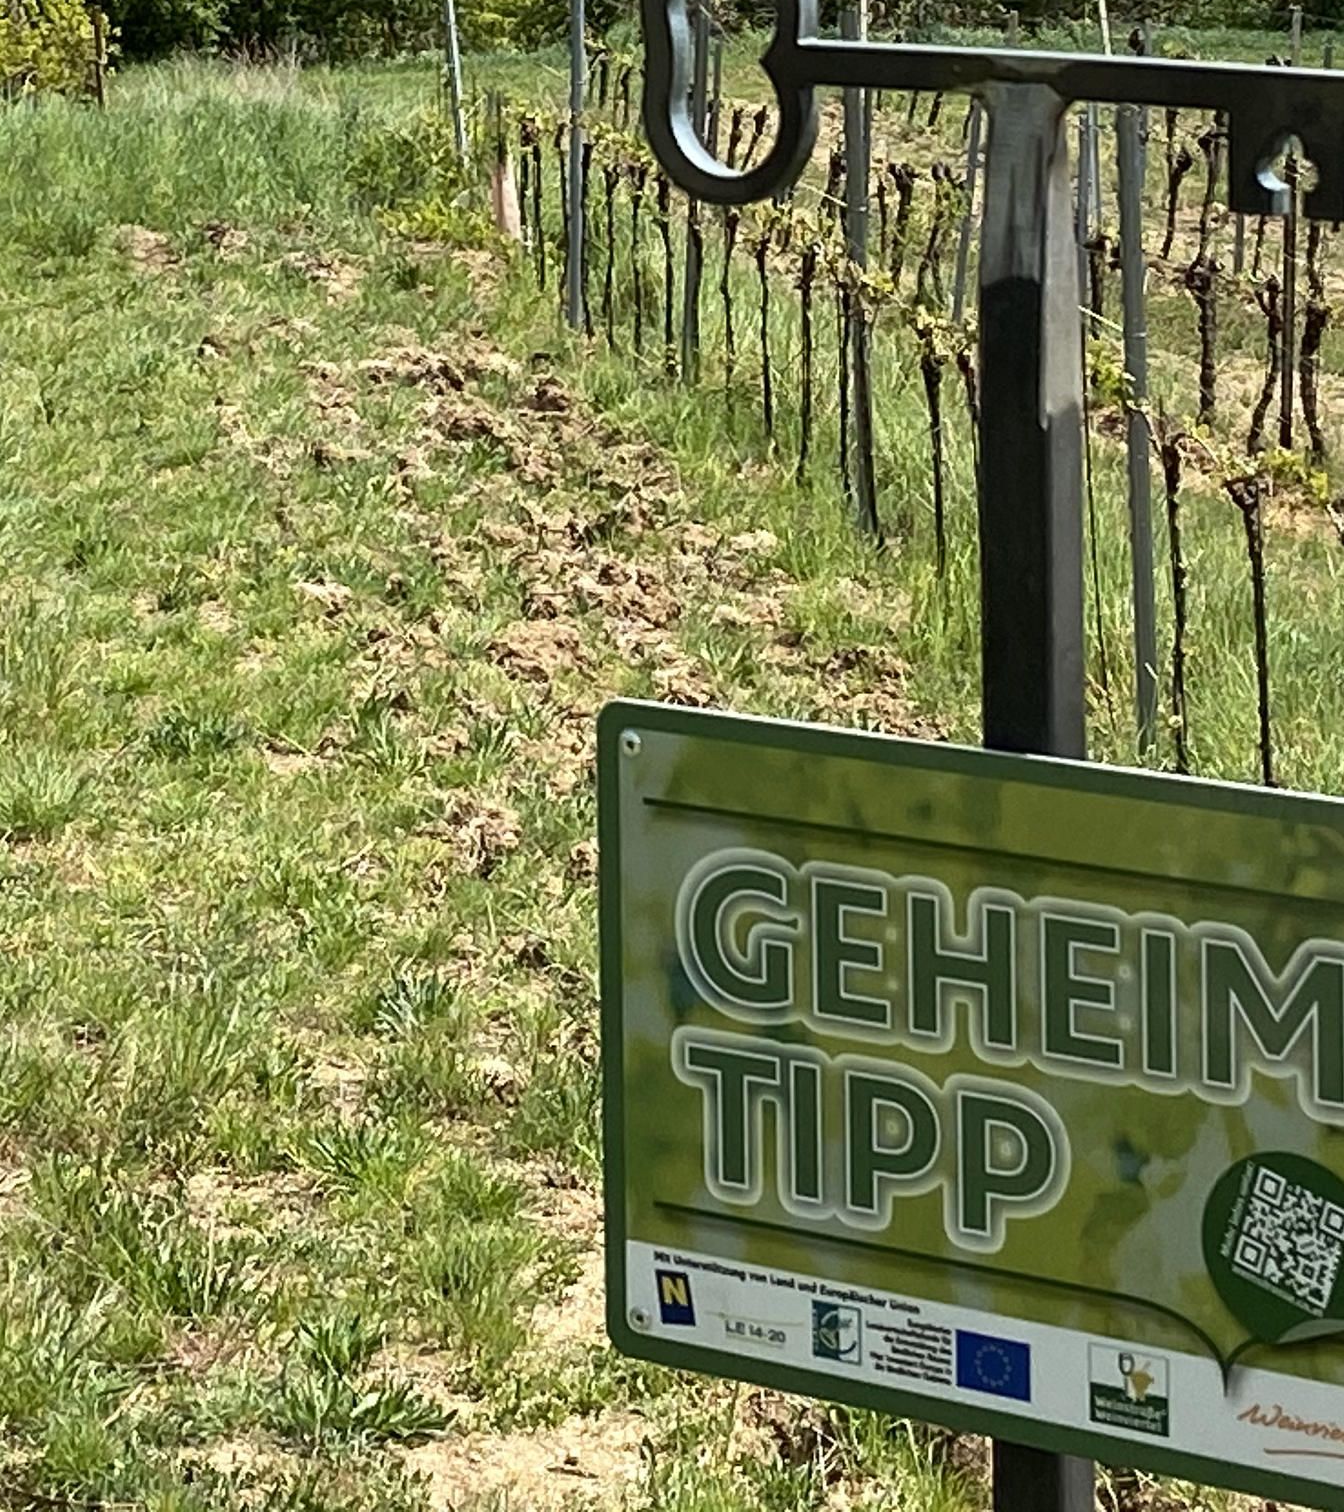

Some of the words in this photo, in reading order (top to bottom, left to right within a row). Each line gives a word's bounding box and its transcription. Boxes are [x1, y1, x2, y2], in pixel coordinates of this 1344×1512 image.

[684, 1042, 1054, 1236] TIPP
[662, 1276, 689, 1306] N
[770, 1273, 795, 1288] Land
[798, 1281, 817, 1294] und
